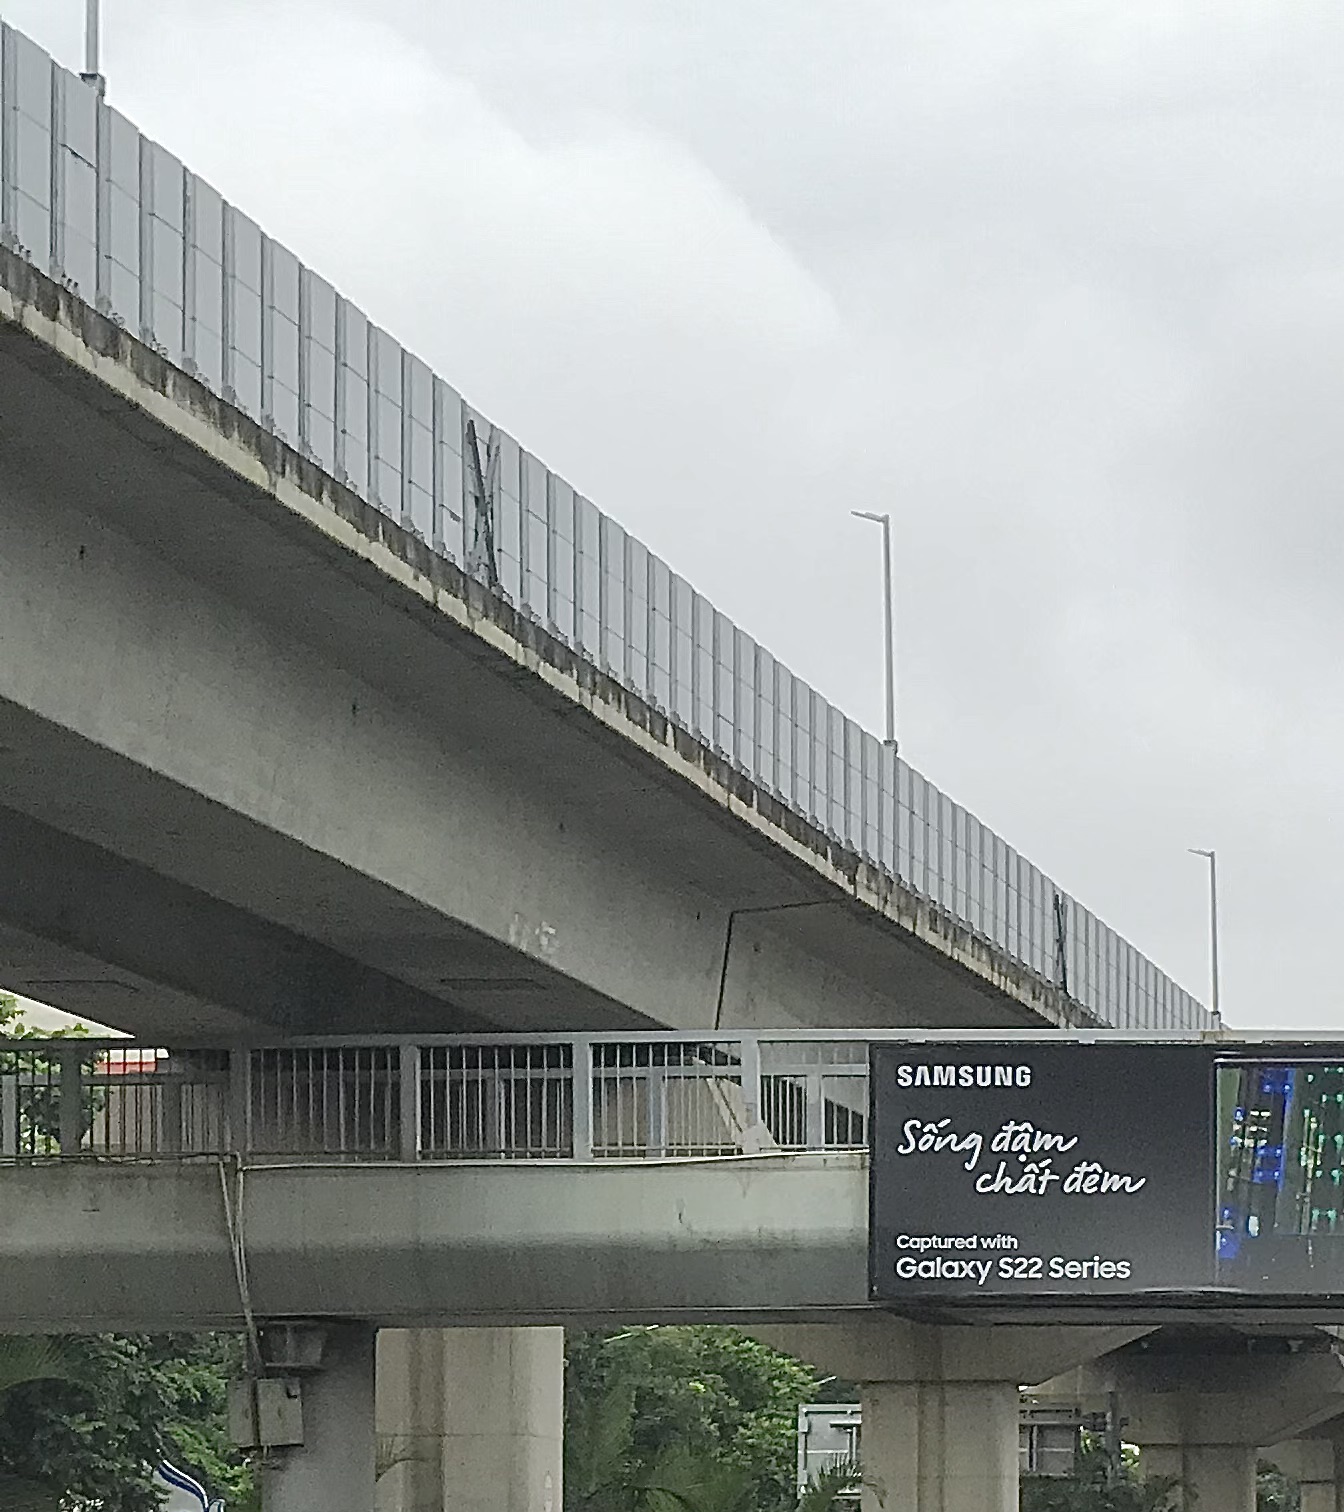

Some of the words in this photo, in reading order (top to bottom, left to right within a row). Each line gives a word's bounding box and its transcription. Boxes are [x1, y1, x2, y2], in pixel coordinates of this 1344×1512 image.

[897, 1065, 1031, 1087] SAMSUNG
[898, 1119, 983, 1170] Sống
[991, 1121, 1078, 1162] đậm
[976, 1159, 1060, 1194] chất
[1063, 1161, 1146, 1193] đêm
[896, 1234, 977, 1252] Captured
[980, 1234, 1018, 1249] with
[896, 1256, 992, 1285] Galaxy
[998, 1257, 1043, 1279] S22
[1048, 1256, 1131, 1279] Series
